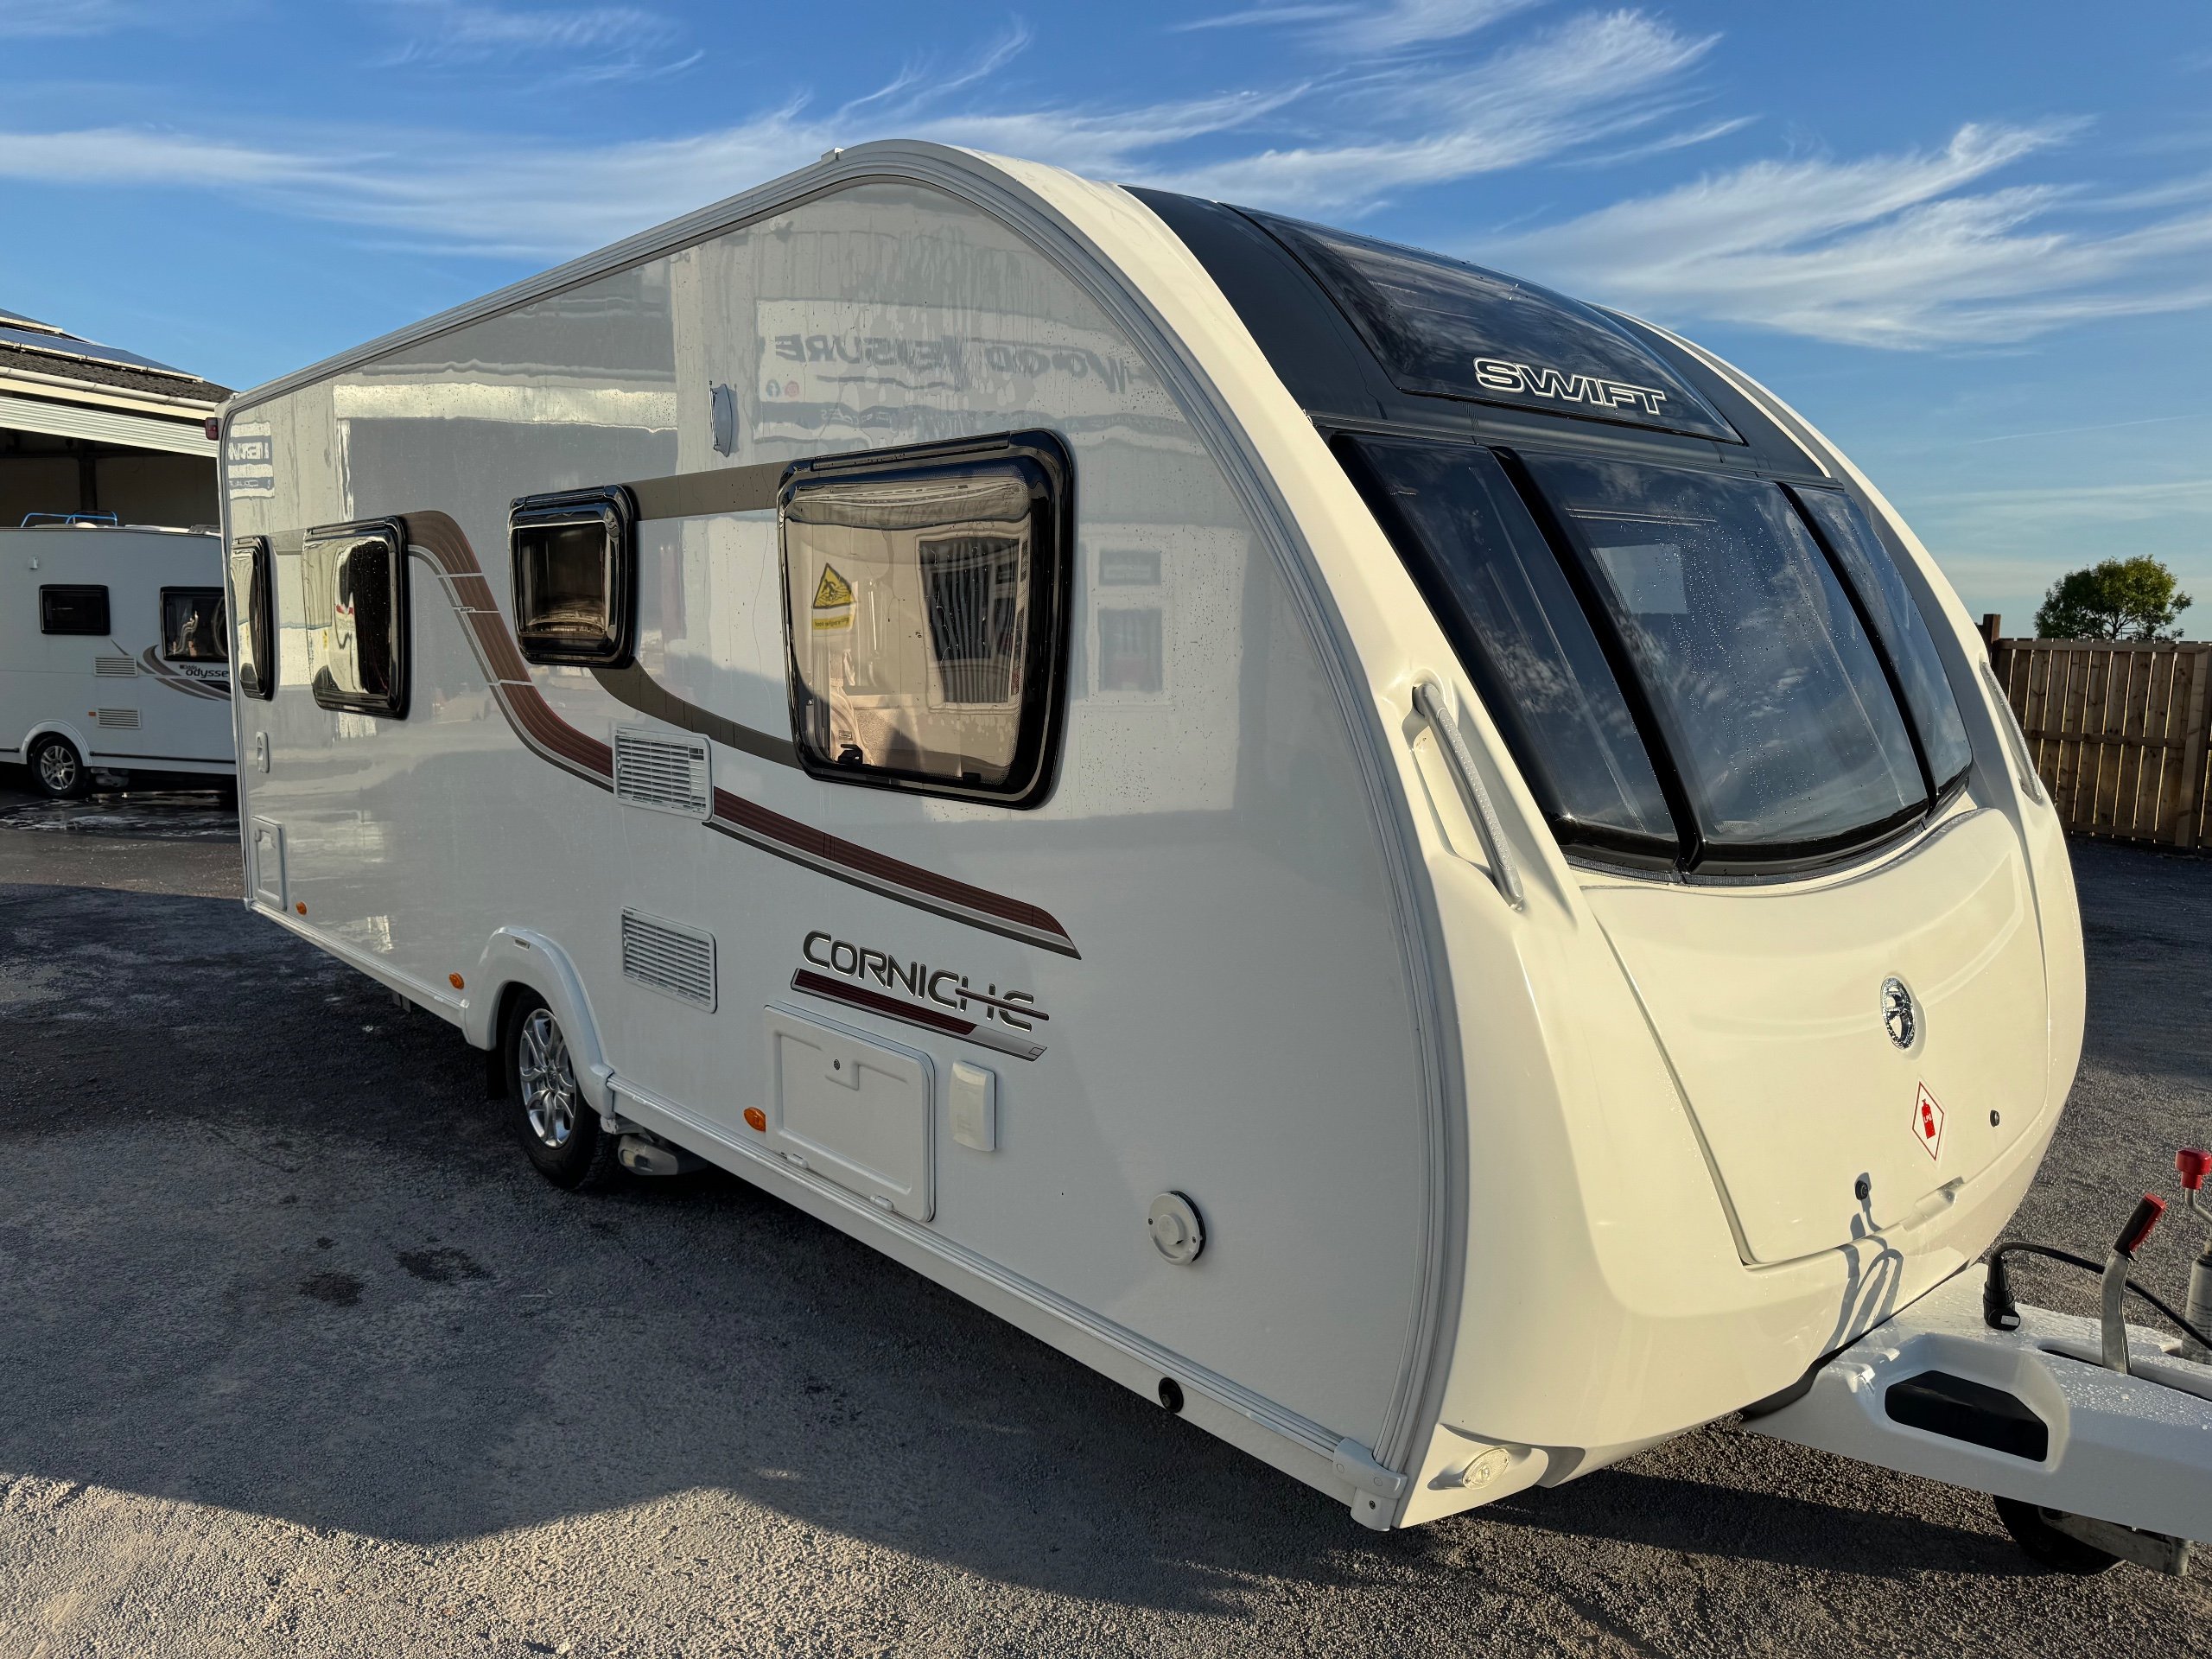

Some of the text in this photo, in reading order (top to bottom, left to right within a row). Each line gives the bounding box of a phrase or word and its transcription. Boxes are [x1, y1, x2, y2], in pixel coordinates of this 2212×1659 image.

[1473, 357, 1667, 416] SWIFT
[186, 668, 229, 678] odysse
[803, 930, 1049, 1032] CORNICHE
